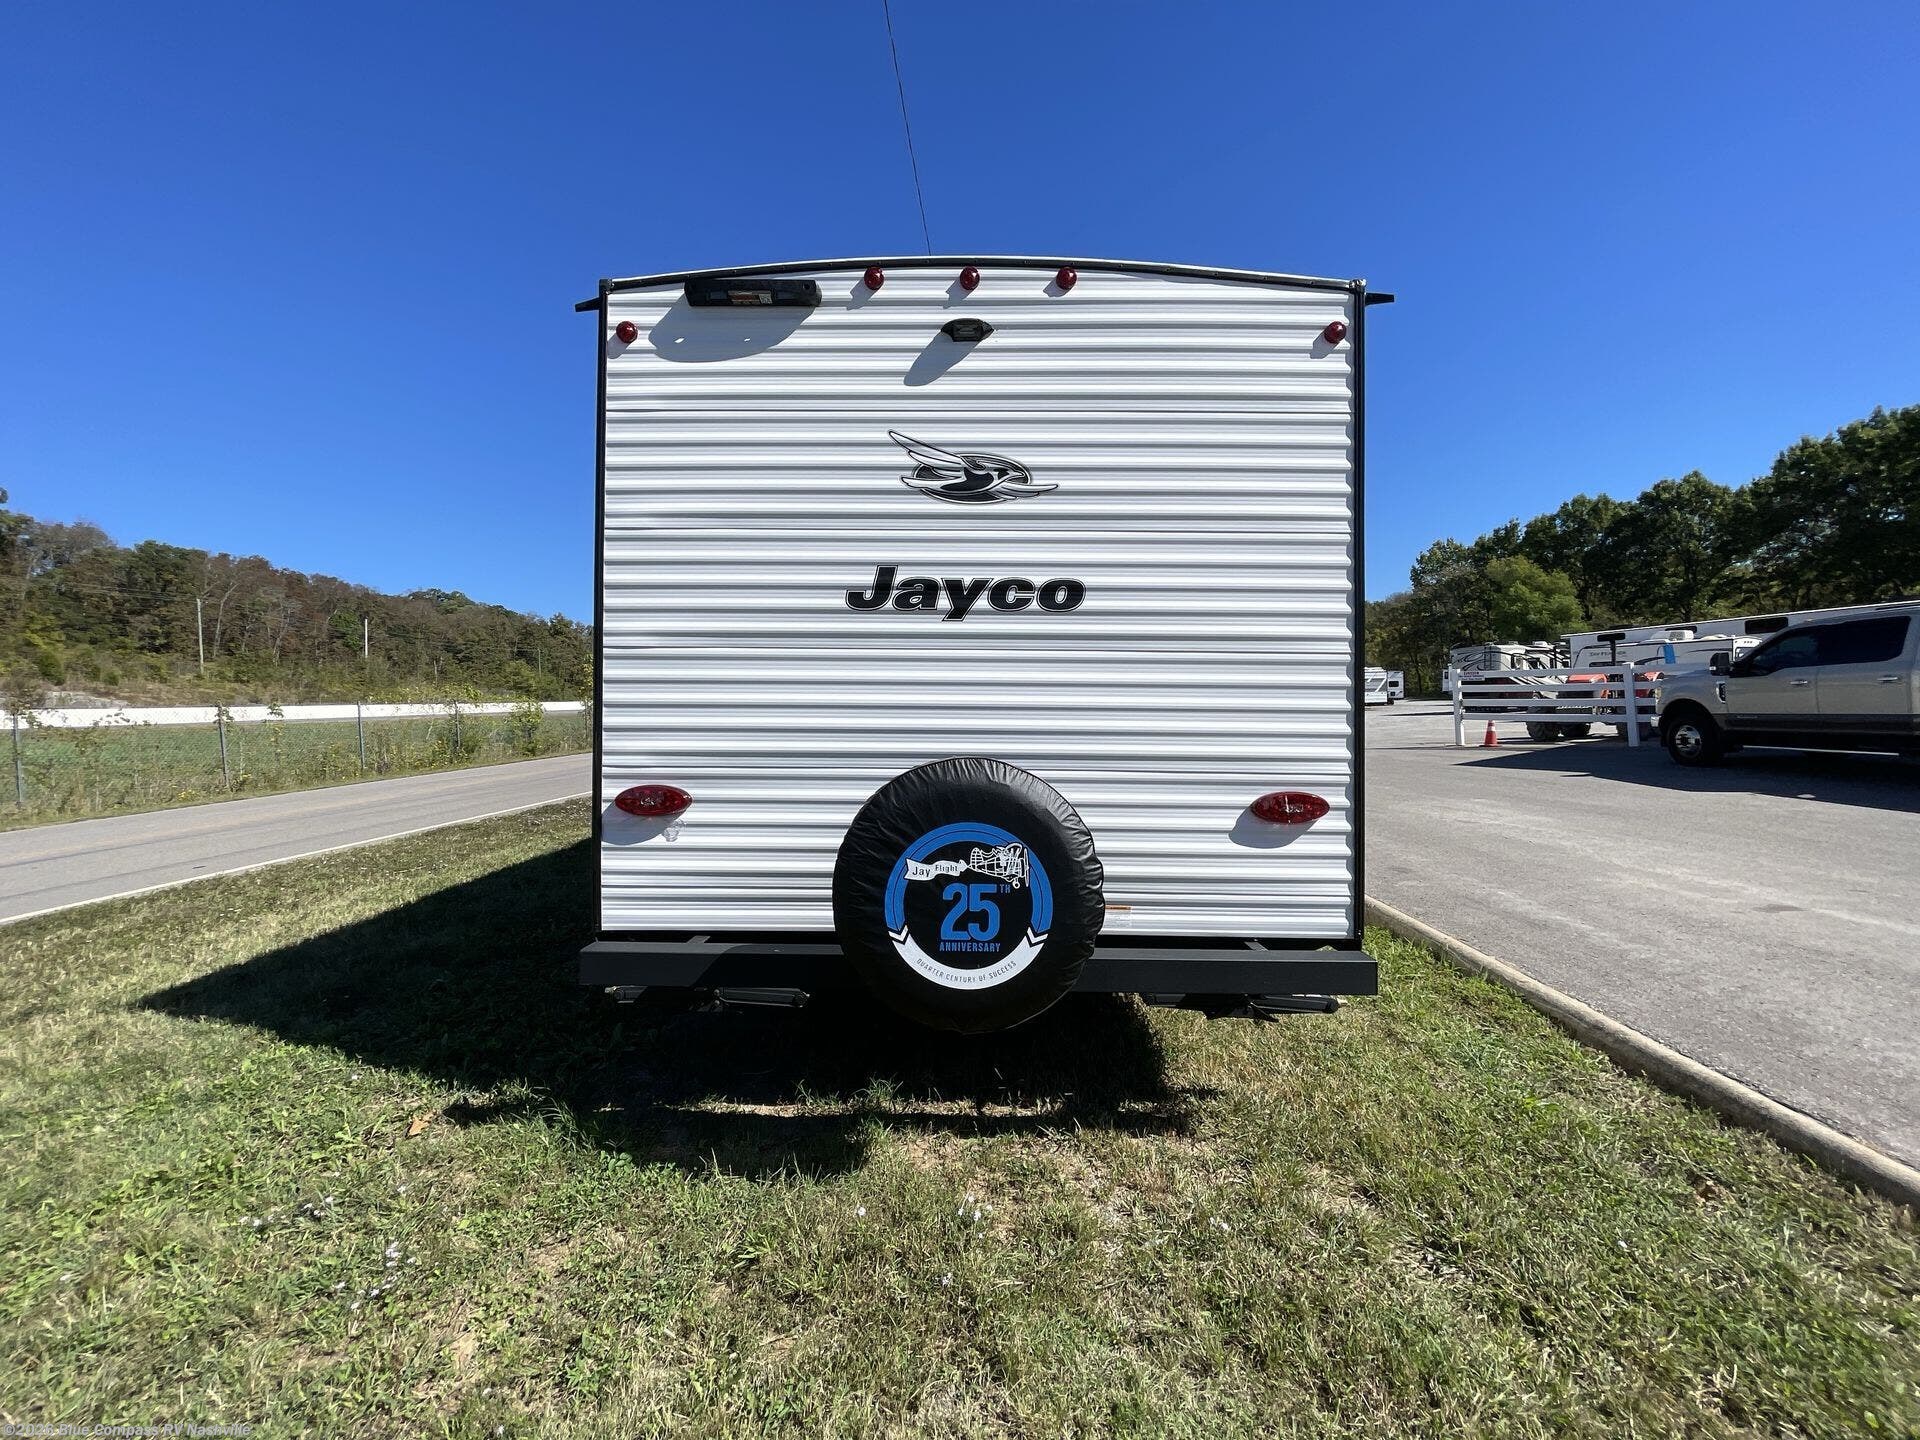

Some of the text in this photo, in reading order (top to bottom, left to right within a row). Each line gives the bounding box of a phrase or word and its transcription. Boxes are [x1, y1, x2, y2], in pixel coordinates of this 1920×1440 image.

[845, 564, 1087, 622] Jayco
[912, 864, 958, 878] Jay Flight
[939, 942, 1001, 952] ANNIVERSARY
[916, 958, 1017, 983] QUARTER CENTURY OF SUCCESS
